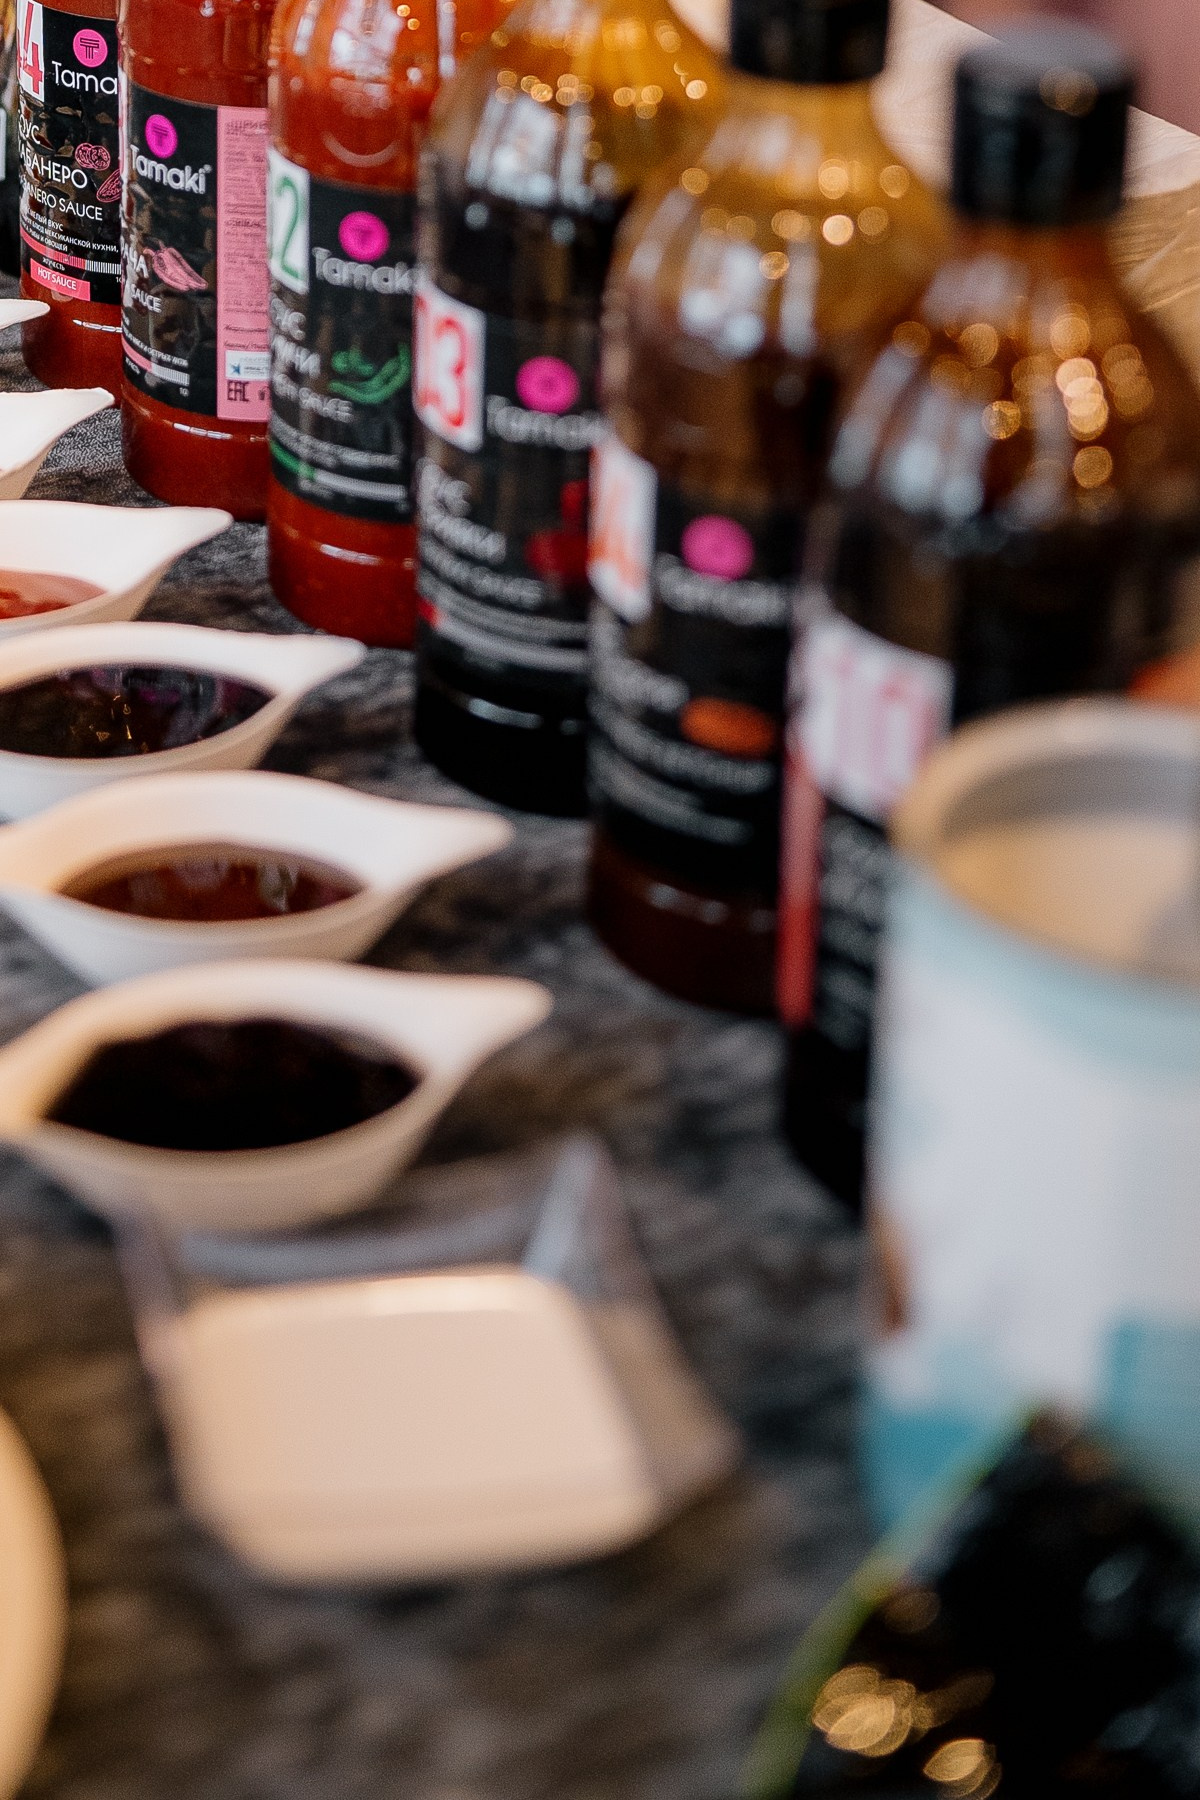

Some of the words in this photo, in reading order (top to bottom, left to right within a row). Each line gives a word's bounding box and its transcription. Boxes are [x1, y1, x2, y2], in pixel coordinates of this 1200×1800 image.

[51, 60, 118, 95] Tama
[129, 144, 207, 195] Tamaki
[58, 198, 103, 221] SAUCE
[47, 218, 64, 232] ВКУС
[92, 242, 119, 253] КУХНИ,
[37, 266, 51, 280] HOT
[52, 273, 77, 290] SAUCE
[312, 246, 417, 295] Tamak
[131, 283, 162, 314] SAUCE
